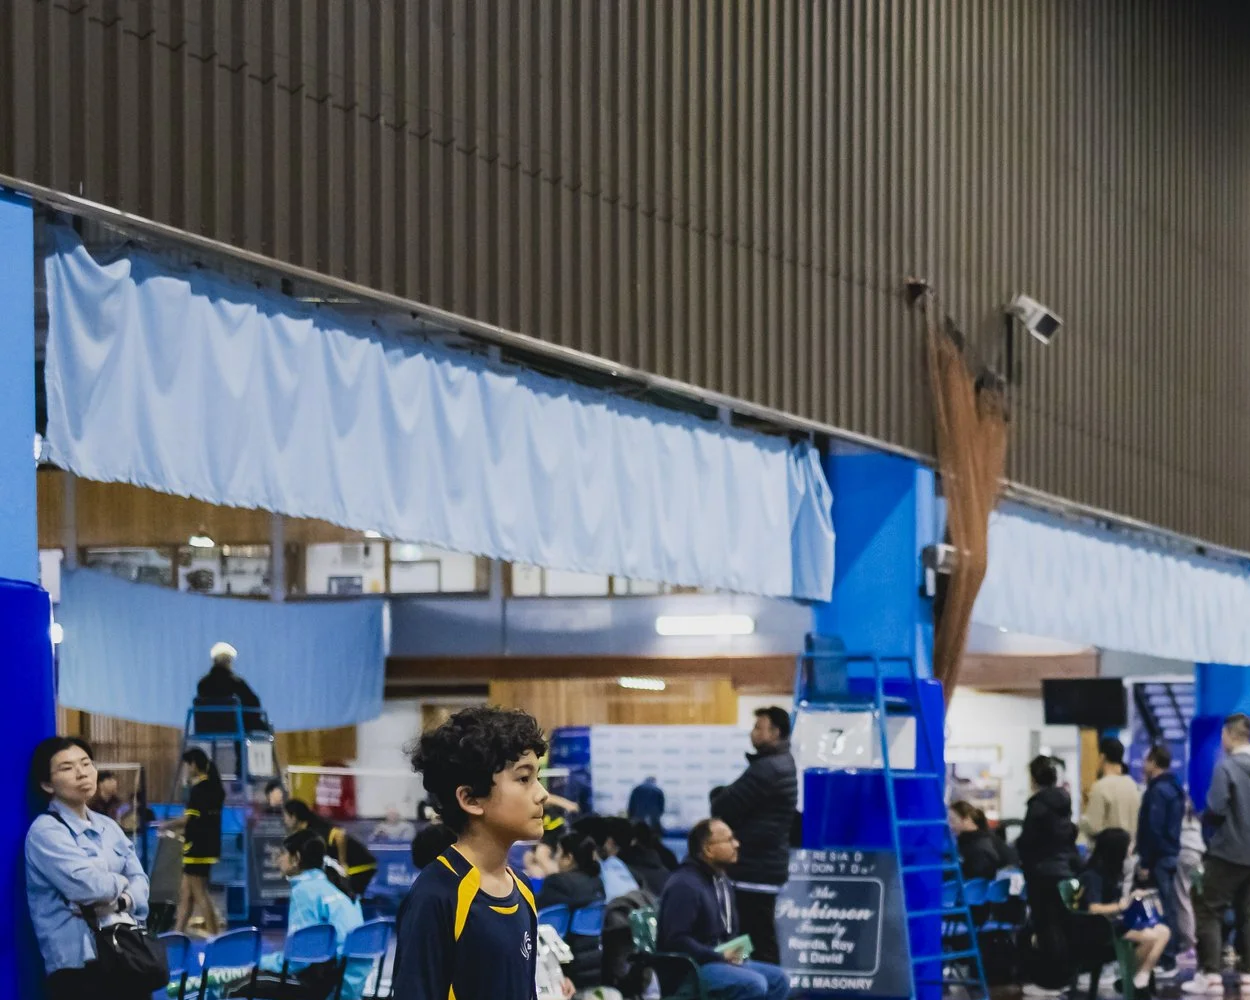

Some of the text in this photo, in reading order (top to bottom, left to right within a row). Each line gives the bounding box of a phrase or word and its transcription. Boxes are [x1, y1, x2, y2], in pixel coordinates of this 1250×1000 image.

[776, 899, 875, 920] Parkinson
[810, 951, 844, 965] David
[812, 976, 873, 990] MASONRY
